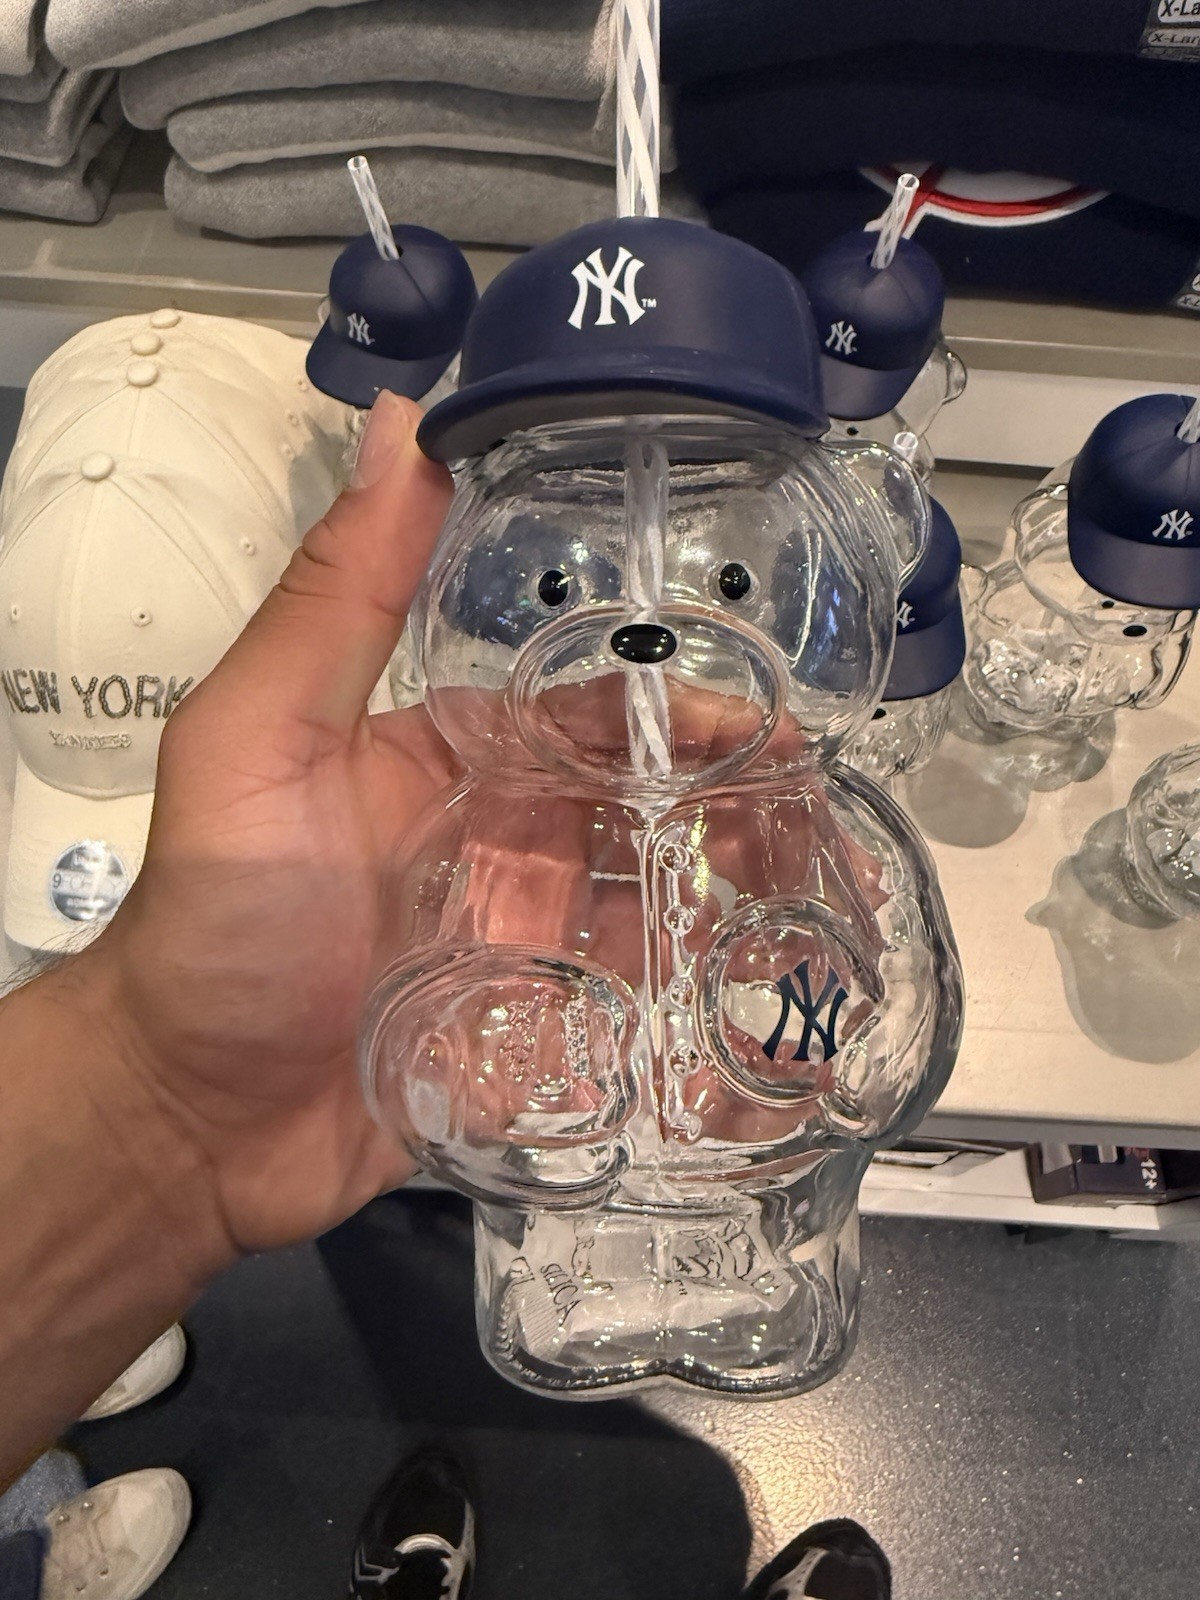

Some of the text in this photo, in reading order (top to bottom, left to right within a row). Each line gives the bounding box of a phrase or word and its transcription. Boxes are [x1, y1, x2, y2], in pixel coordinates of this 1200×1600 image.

[1150, 33, 1200, 46] X-Lar
[567, 246, 646, 330] NY
[346, 312, 371, 346] NY
[825, 320, 857, 355] NY
[1151, 509, 1194, 540] NY
[0, 669, 194, 718] NEW YORK
[762, 959, 849, 1063] NY
